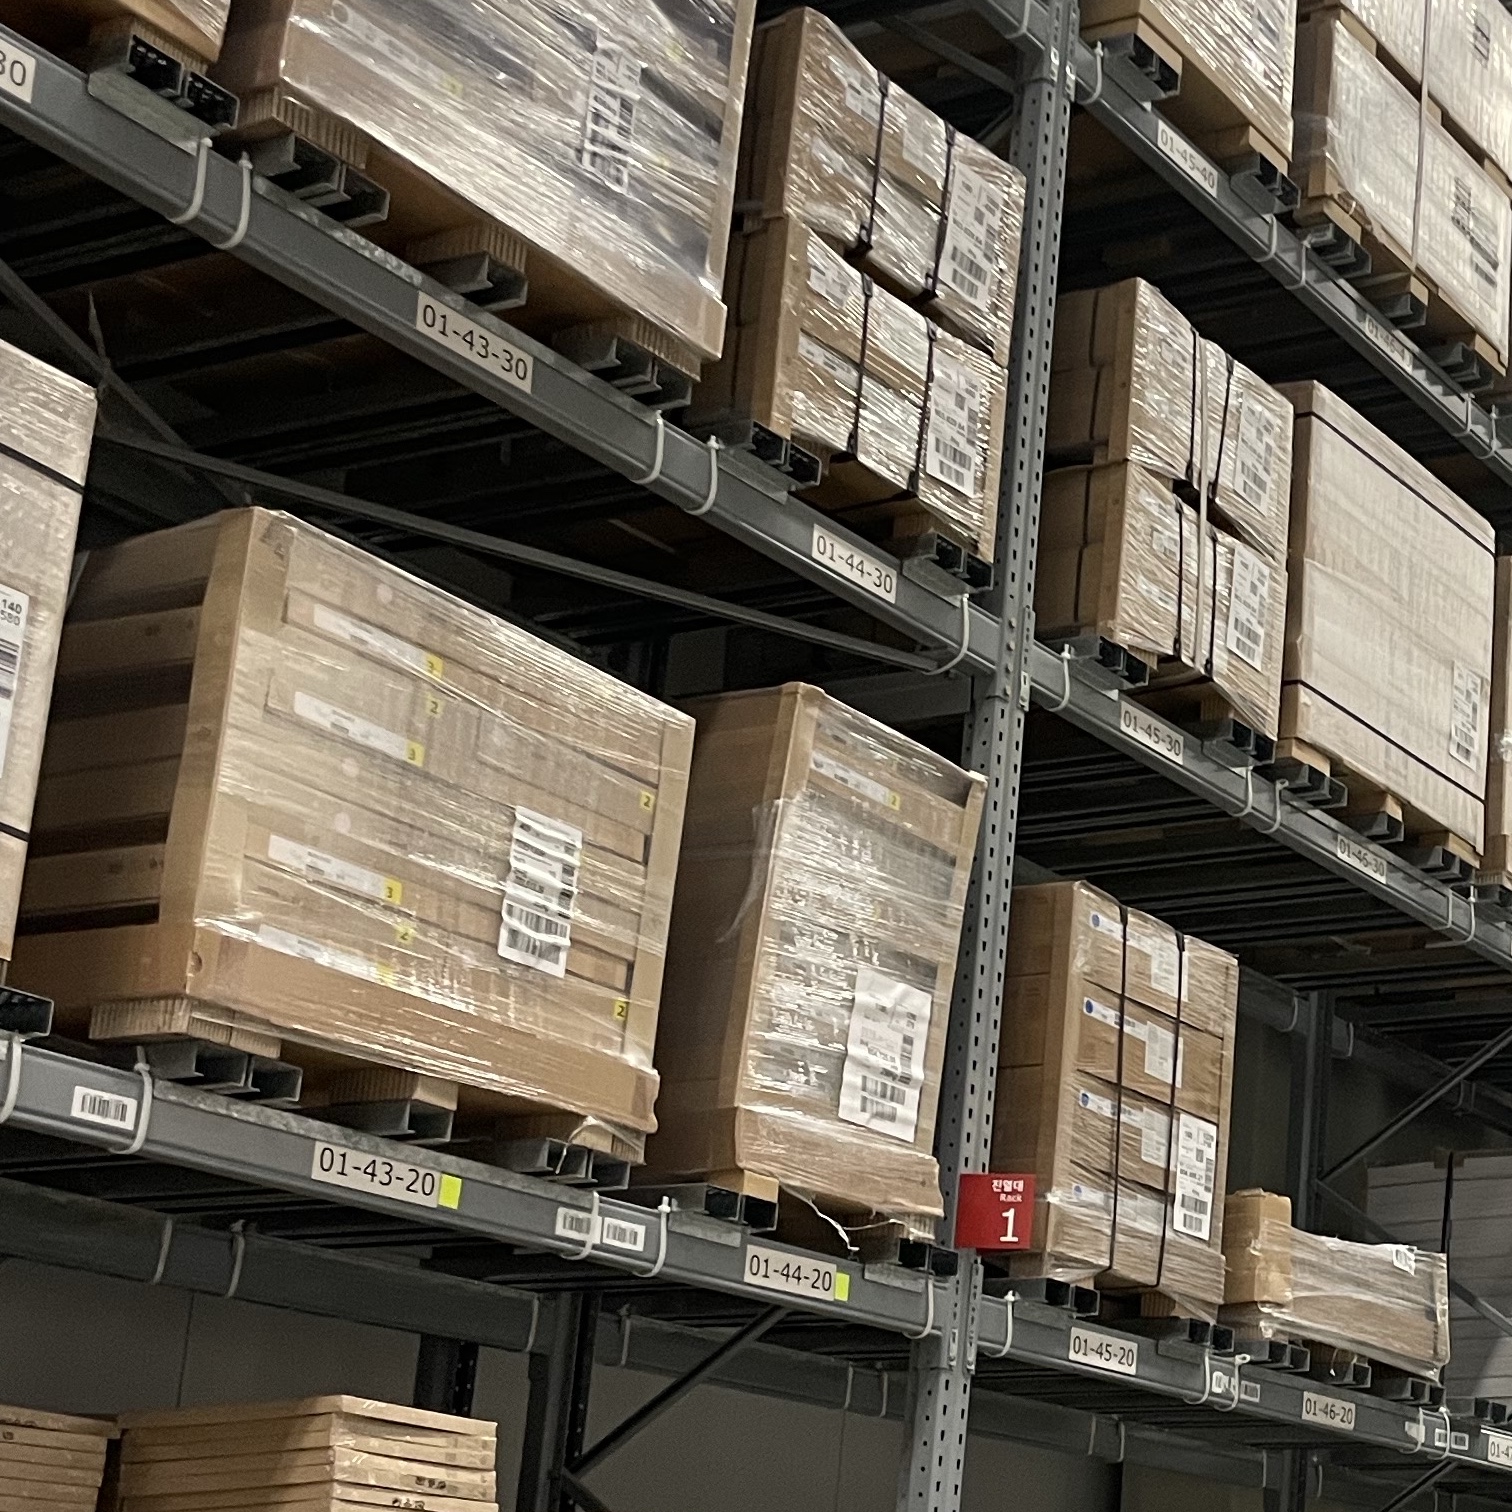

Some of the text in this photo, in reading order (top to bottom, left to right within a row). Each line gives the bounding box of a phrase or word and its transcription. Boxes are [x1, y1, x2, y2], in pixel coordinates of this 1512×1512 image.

[1160, 129, 1217, 189] 01-45-40
[421, 304, 529, 382] 01-43-30
[815, 535, 894, 595] 01-44-30
[1122, 709, 1182, 759] 01-45-30
[1339, 837, 1387, 878] 01-46-30
[319, 1147, 435, 1198] 01-43-20
[1000, 1193, 1022, 1202] Rack
[1000, 1207, 1019, 1242] 1
[748, 1249, 833, 1293] 01-44-20
[1072, 1334, 1135, 1368] 01-45-20
[1304, 1398, 1355, 1427] 01-46-20
